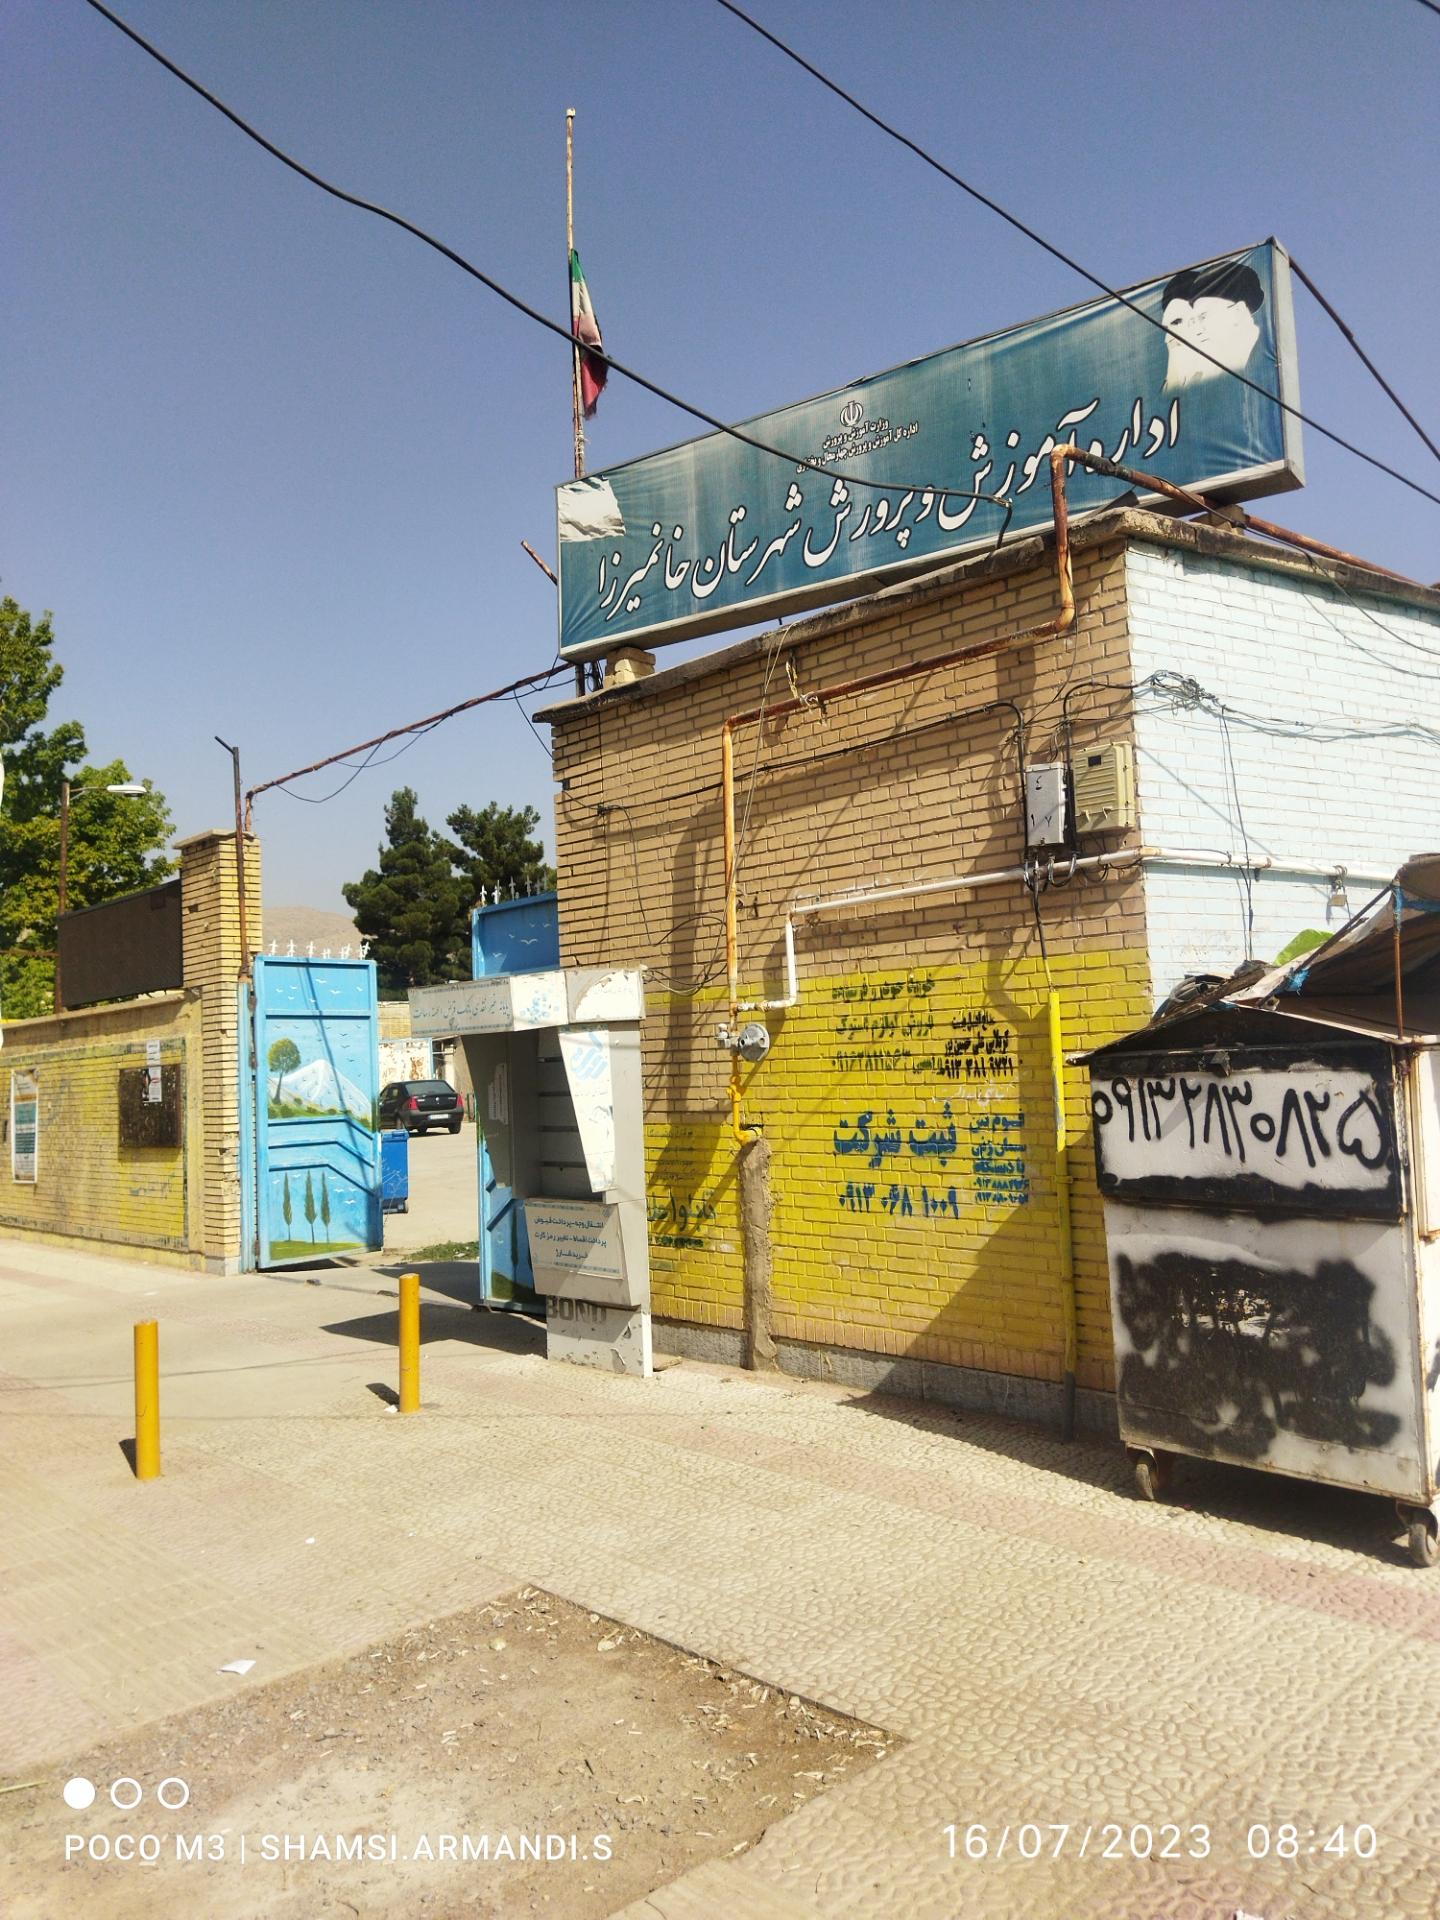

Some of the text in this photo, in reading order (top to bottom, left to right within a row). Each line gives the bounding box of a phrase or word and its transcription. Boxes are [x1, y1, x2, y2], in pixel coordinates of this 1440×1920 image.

[848, 421, 869, 441] آموزش
[870, 417, 889, 433] وزارت
[893, 427, 903, 443] کل
[902, 421, 918, 439] اداره
[823, 433, 844, 449] پرورش
[848, 441, 868, 457] پرورش
[872, 429, 893, 449] آموزش
[598, 397, 1180, 622] اداره آموزش و پرورش شهرستان خانمیرزا
[1091, 1077, 1389, 1169] ۰۹۱۳۲۸۳۰۸۲۵
[833, 1102, 957, 1168] ثبت شرکت
[838, 1181, 876, 1213] ۰۹۱۳
[921, 1185, 960, 1220] ۱۰۰۹
